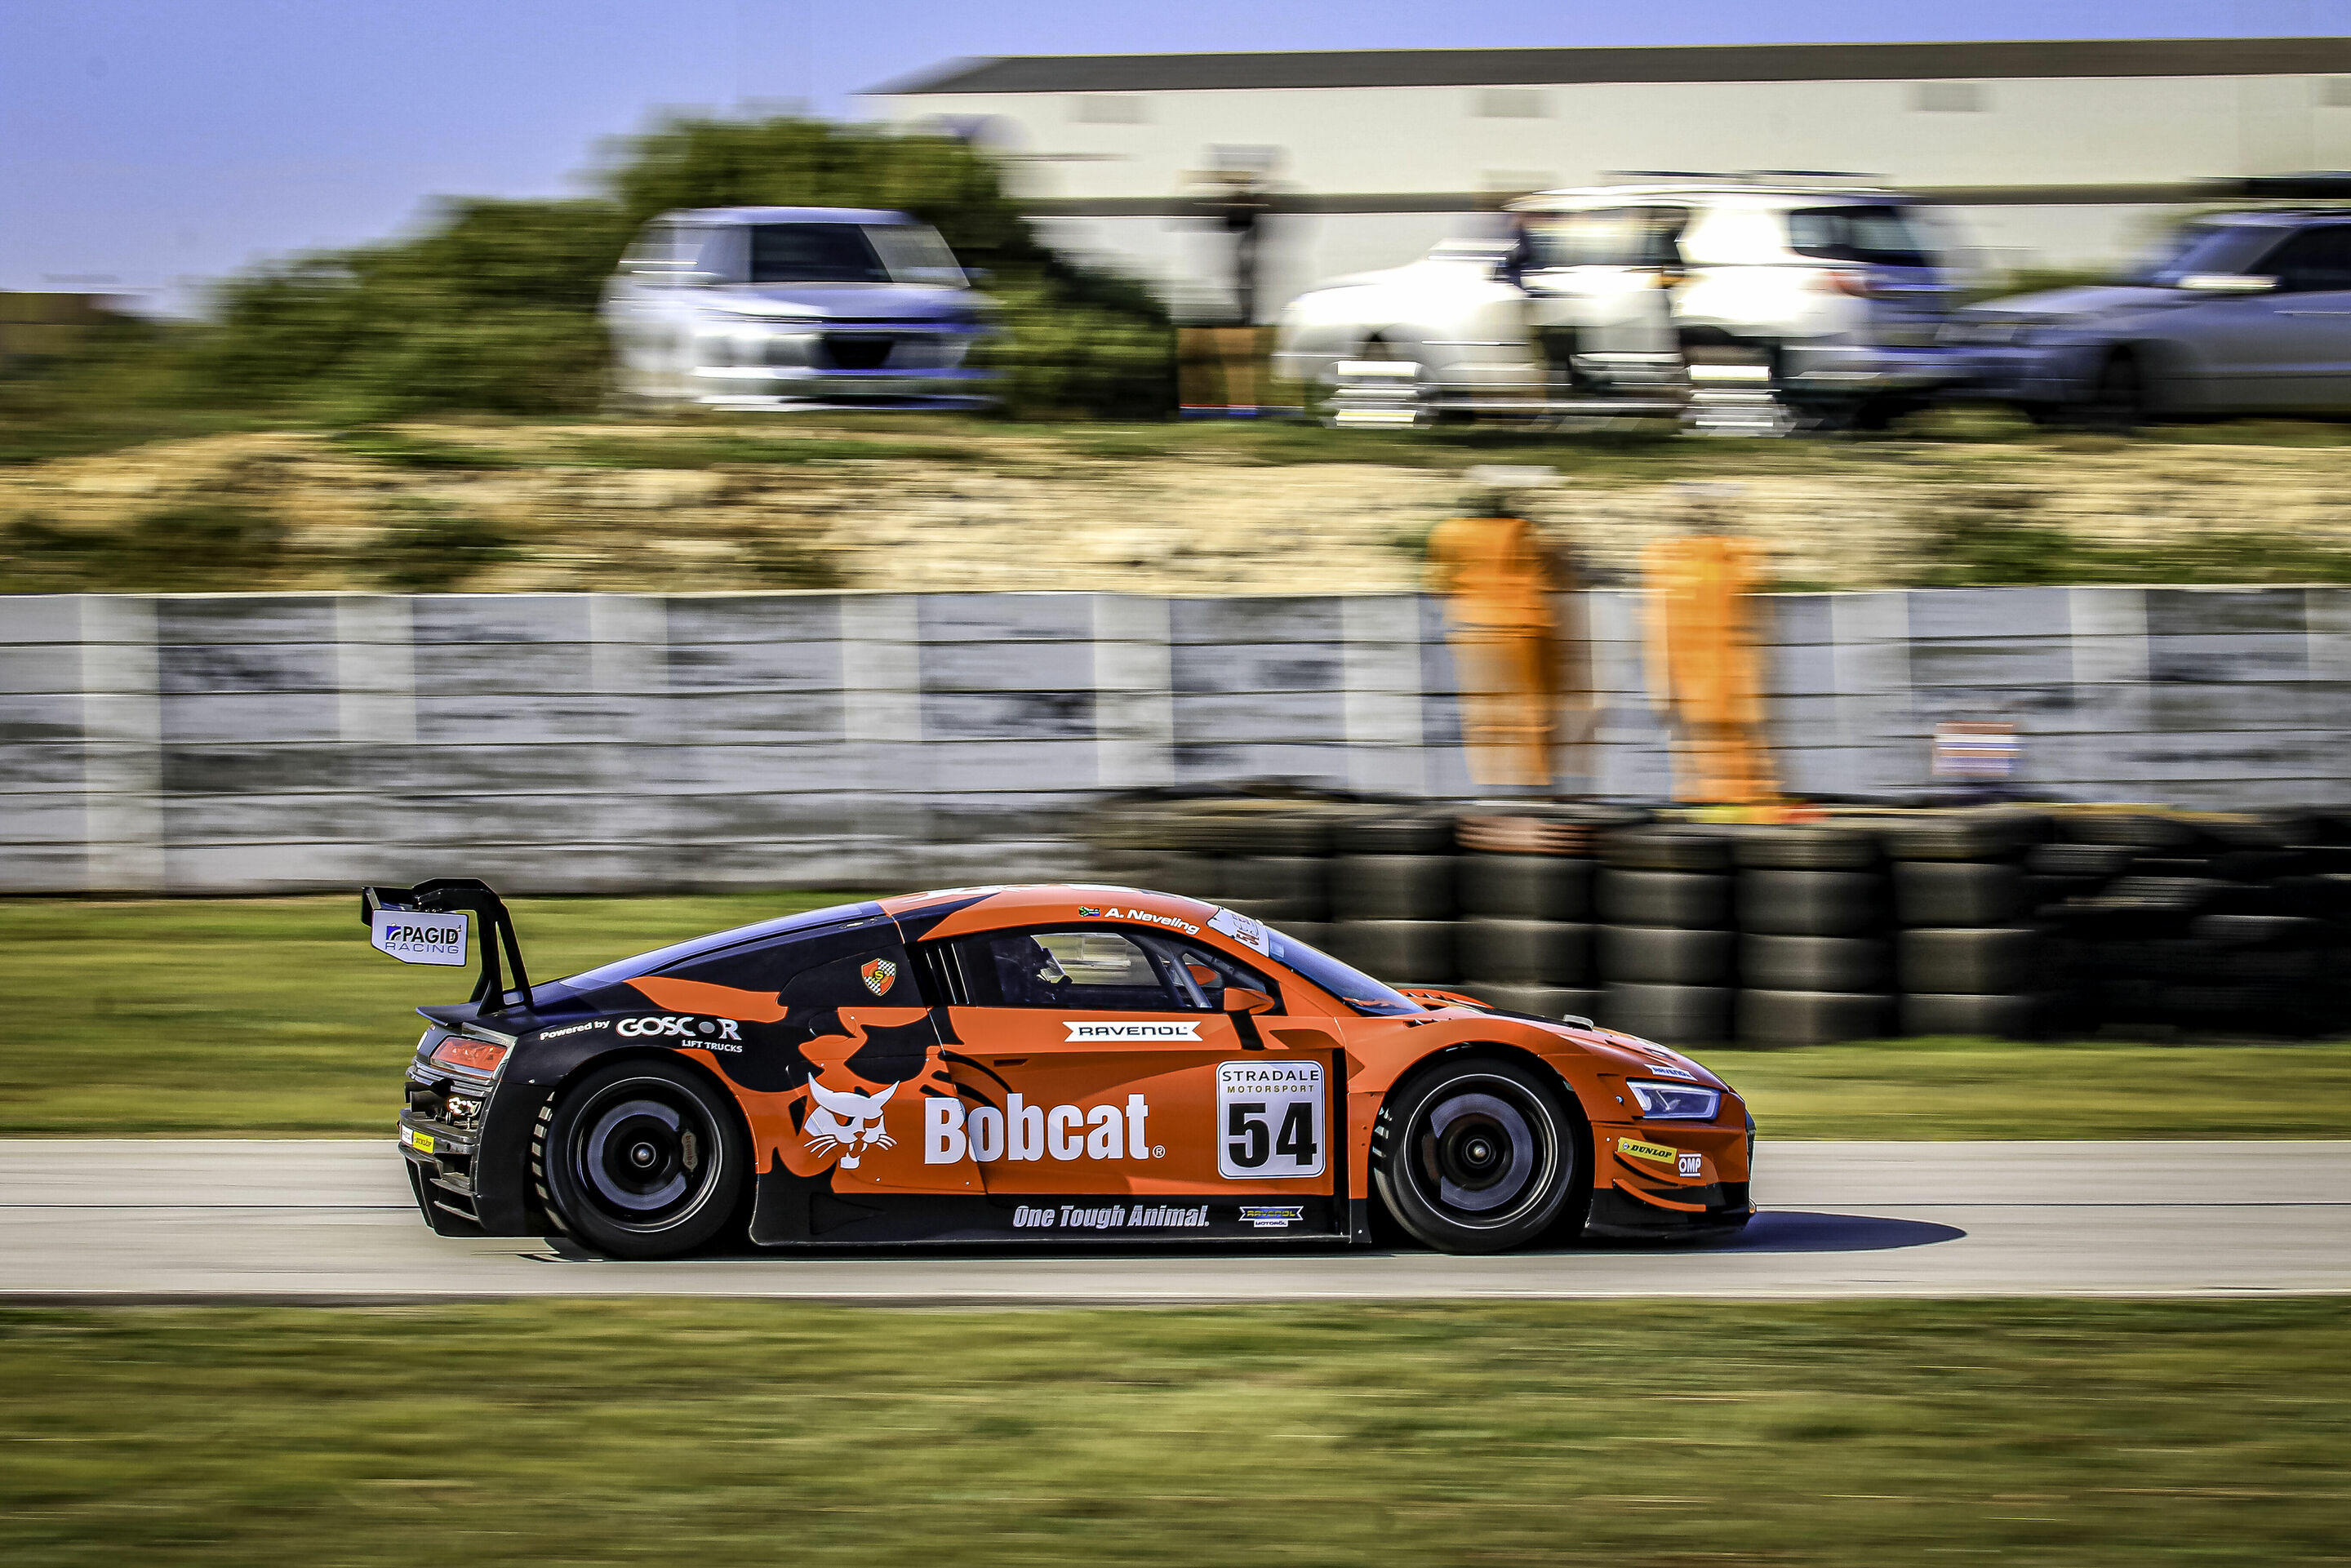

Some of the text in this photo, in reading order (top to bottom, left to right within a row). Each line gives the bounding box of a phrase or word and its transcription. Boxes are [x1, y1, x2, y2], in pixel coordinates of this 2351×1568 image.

[1104, 908, 1201, 935] A. Neveling
[402, 926, 459, 944] PAGID
[384, 942, 459, 954] RACING
[540, 1021, 593, 1041] Powered
[593, 1020, 611, 1032] by
[1078, 1026, 1189, 1037] RAVENOL
[681, 1039, 744, 1053] LIFT TRUCKS
[1222, 1070, 1320, 1082] STRADALE
[1227, 1085, 1314, 1094] MOTORSPORT
[1228, 1102, 1318, 1168] 54
[1630, 1144, 1673, 1158] DUNLOP
[1678, 1157, 1701, 1173] OMP
[1013, 1204, 1210, 1229] One Tough Animal.
